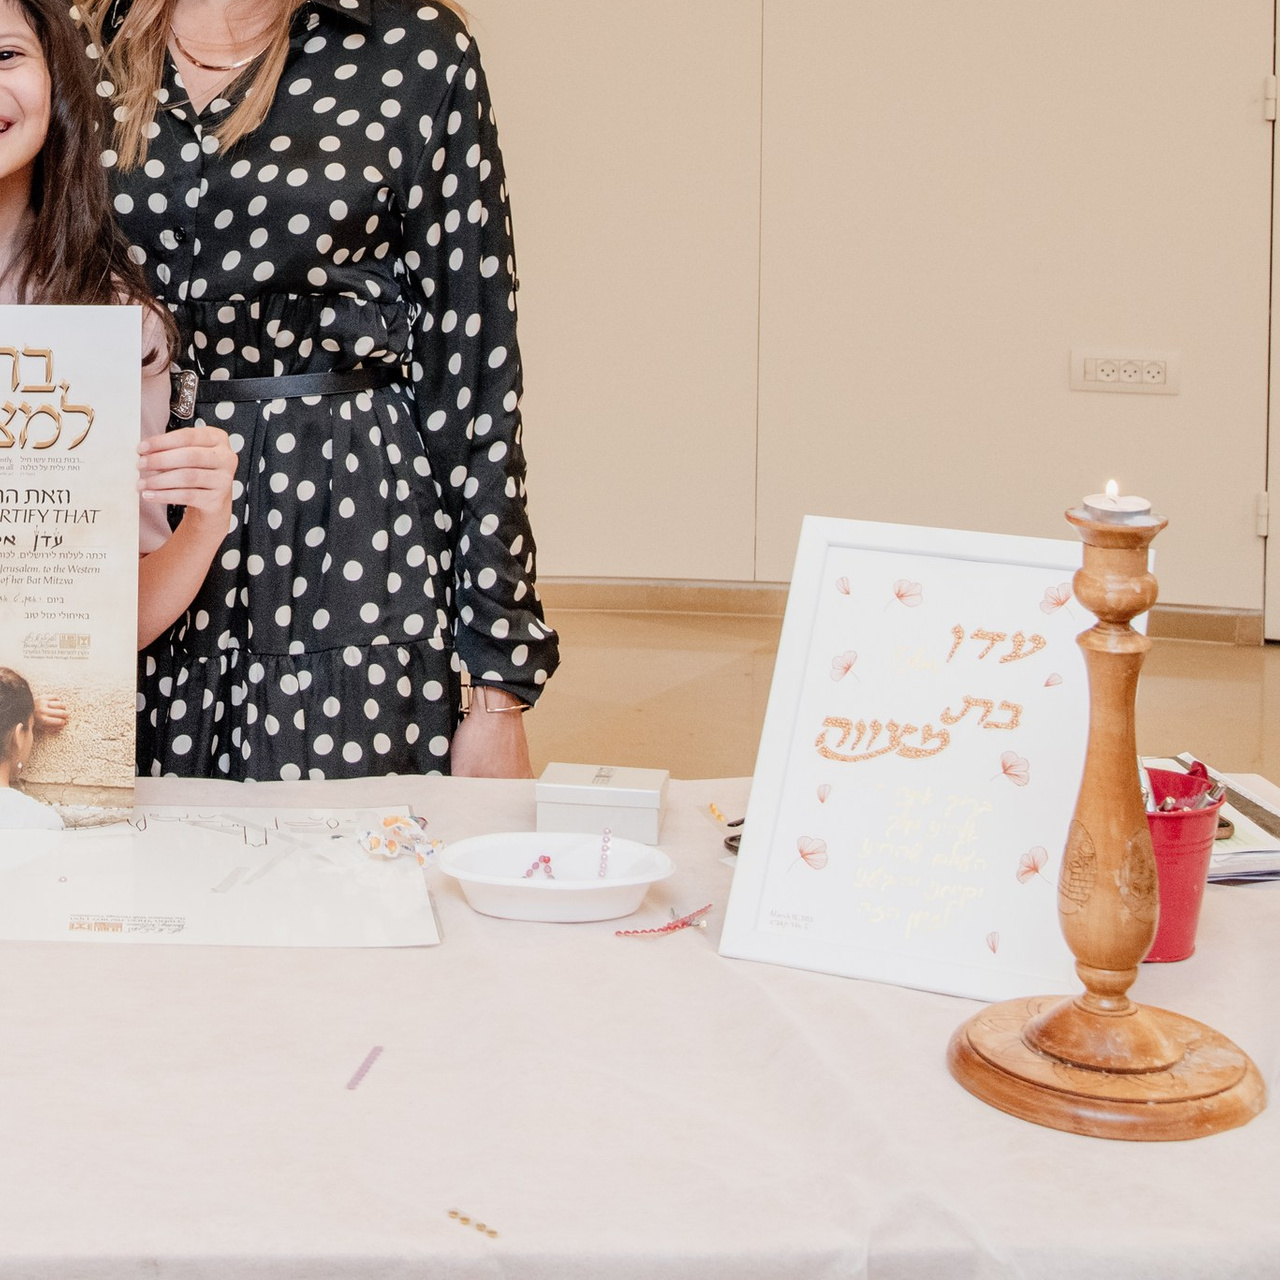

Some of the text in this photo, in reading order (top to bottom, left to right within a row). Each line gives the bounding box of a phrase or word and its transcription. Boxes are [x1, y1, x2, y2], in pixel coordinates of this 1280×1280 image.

[26, 489, 72, 505] וזאת
[52, 509, 101, 524] THAT
[33, 527, 63, 552] עדן
[59, 551, 84, 560] לעלות
[42, 565, 52, 573] to
[53, 564, 66, 573] the
[67, 565, 100, 574] Western
[0, 575, 10, 587] of
[11, 575, 24, 584] her
[26, 575, 41, 584] Bat
[42, 576, 74, 585] Mitzva
[46, 596, 65, 604] ביום
[24, 610, 90, 620] באיחולי מזל טוב
[946, 624, 1047, 663] עדן
[940, 695, 1023, 730] בת
[815, 715, 951, 762] מצווה
